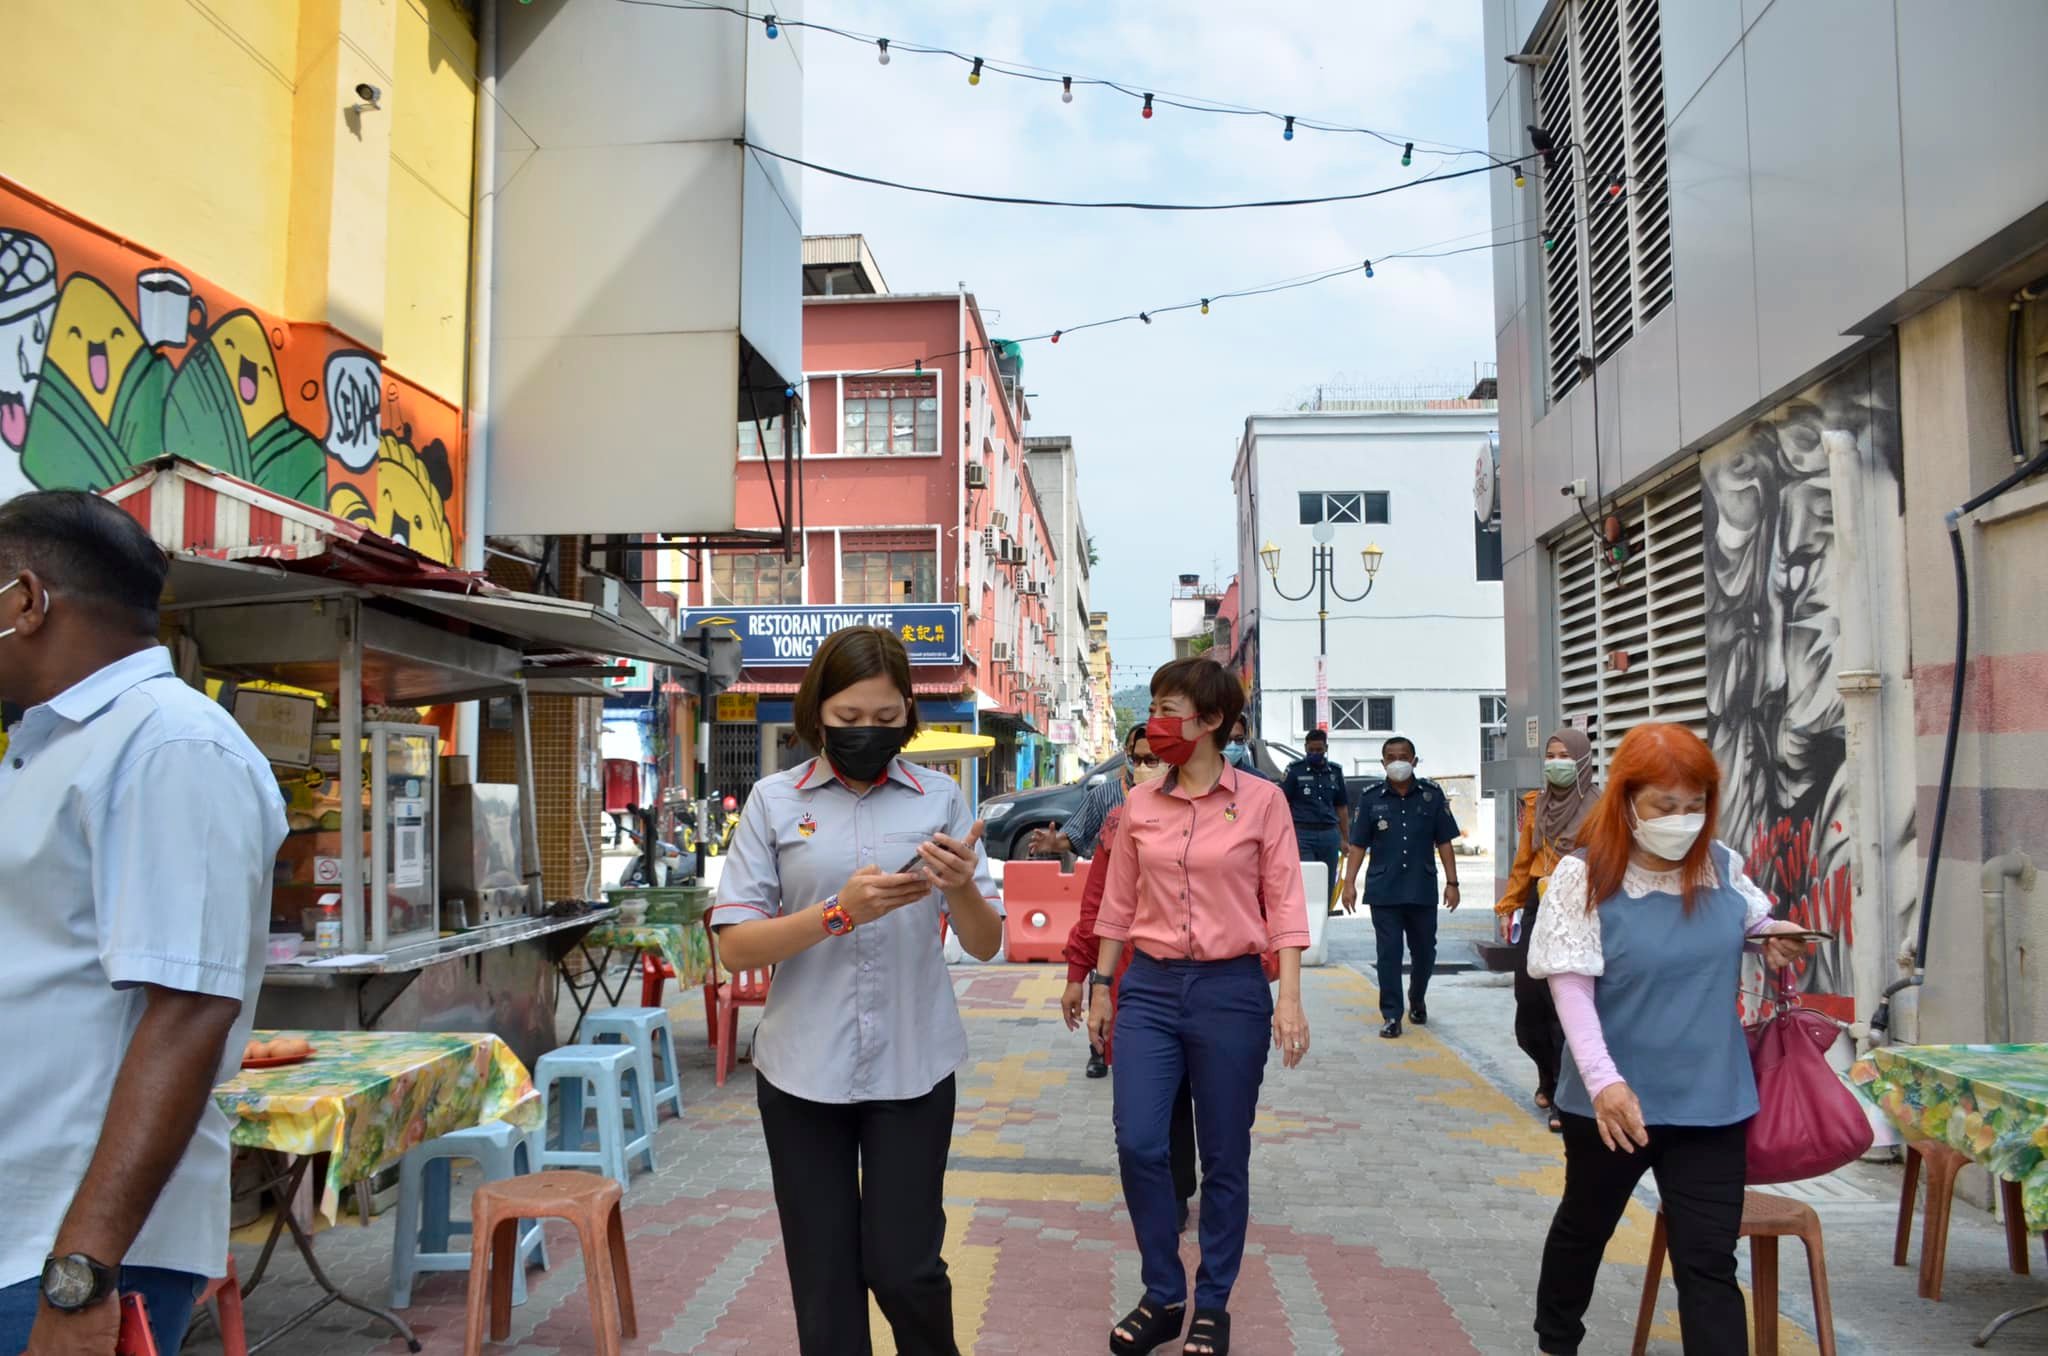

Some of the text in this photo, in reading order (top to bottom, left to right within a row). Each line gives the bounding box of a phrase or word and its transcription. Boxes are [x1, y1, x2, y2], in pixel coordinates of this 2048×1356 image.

[335, 366, 380, 448] SEDAP
[749, 614, 820, 635] RESTORAN
[772, 636, 812, 657] YONG
